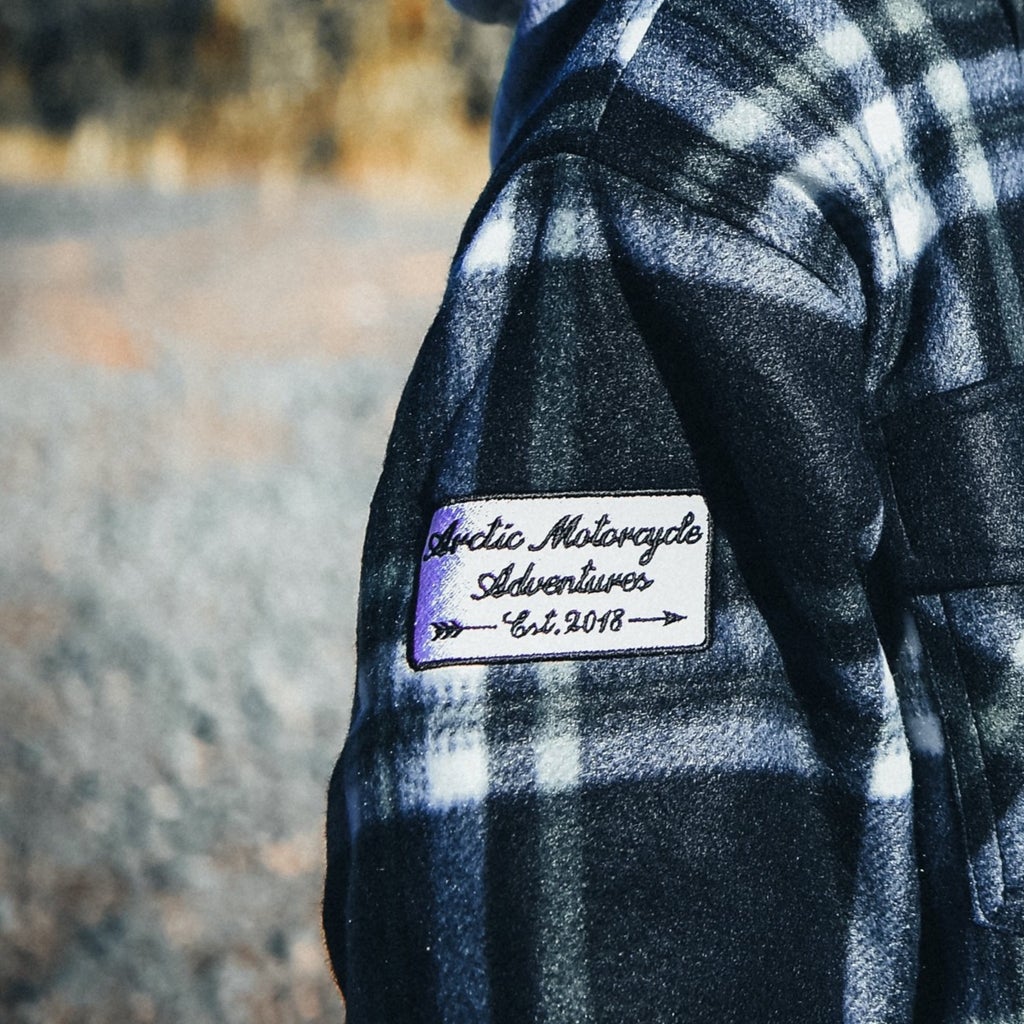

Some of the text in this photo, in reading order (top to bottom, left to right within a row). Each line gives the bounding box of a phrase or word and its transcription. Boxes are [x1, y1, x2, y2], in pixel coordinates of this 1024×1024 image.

[423, 511, 703, 566] Arctic Motorcycle
[470, 559, 655, 601] Adventures
